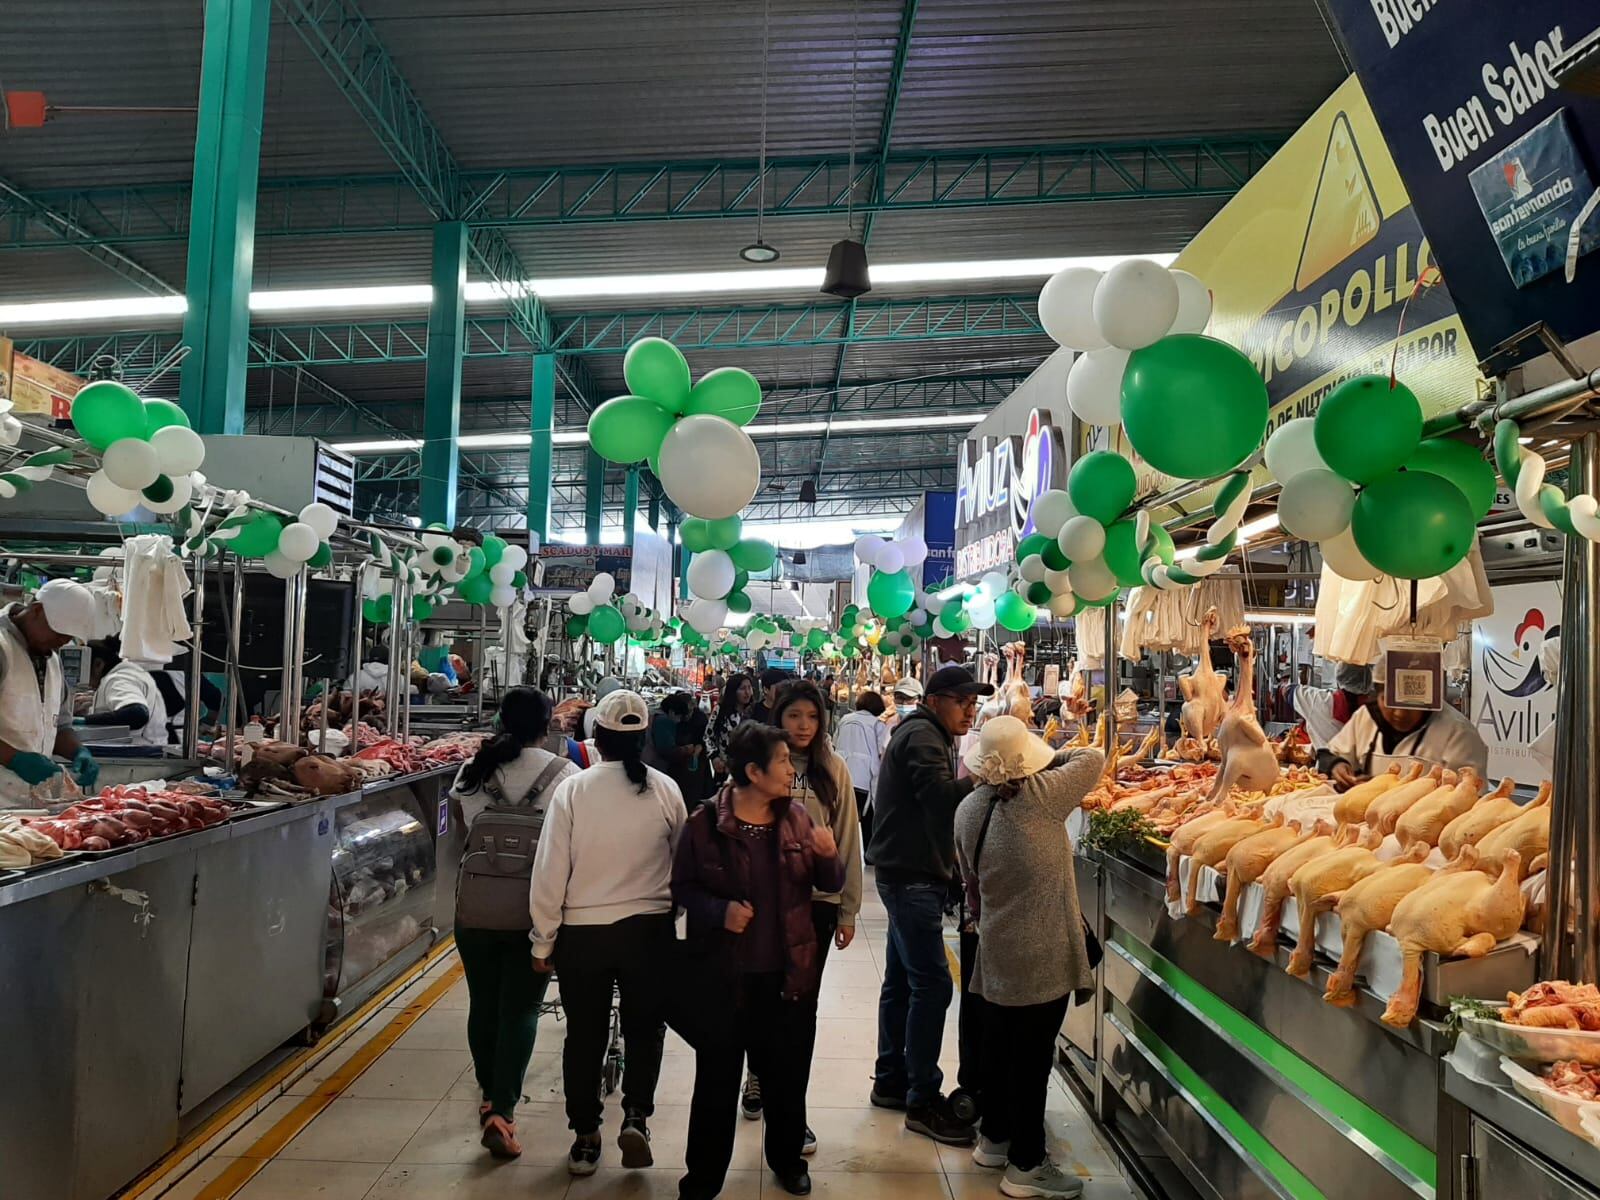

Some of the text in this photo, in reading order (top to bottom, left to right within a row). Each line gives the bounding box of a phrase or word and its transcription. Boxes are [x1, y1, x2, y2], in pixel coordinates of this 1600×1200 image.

[1422, 25, 1564, 172] Buen Sabor
[543, 546, 590, 556] SCADOS
